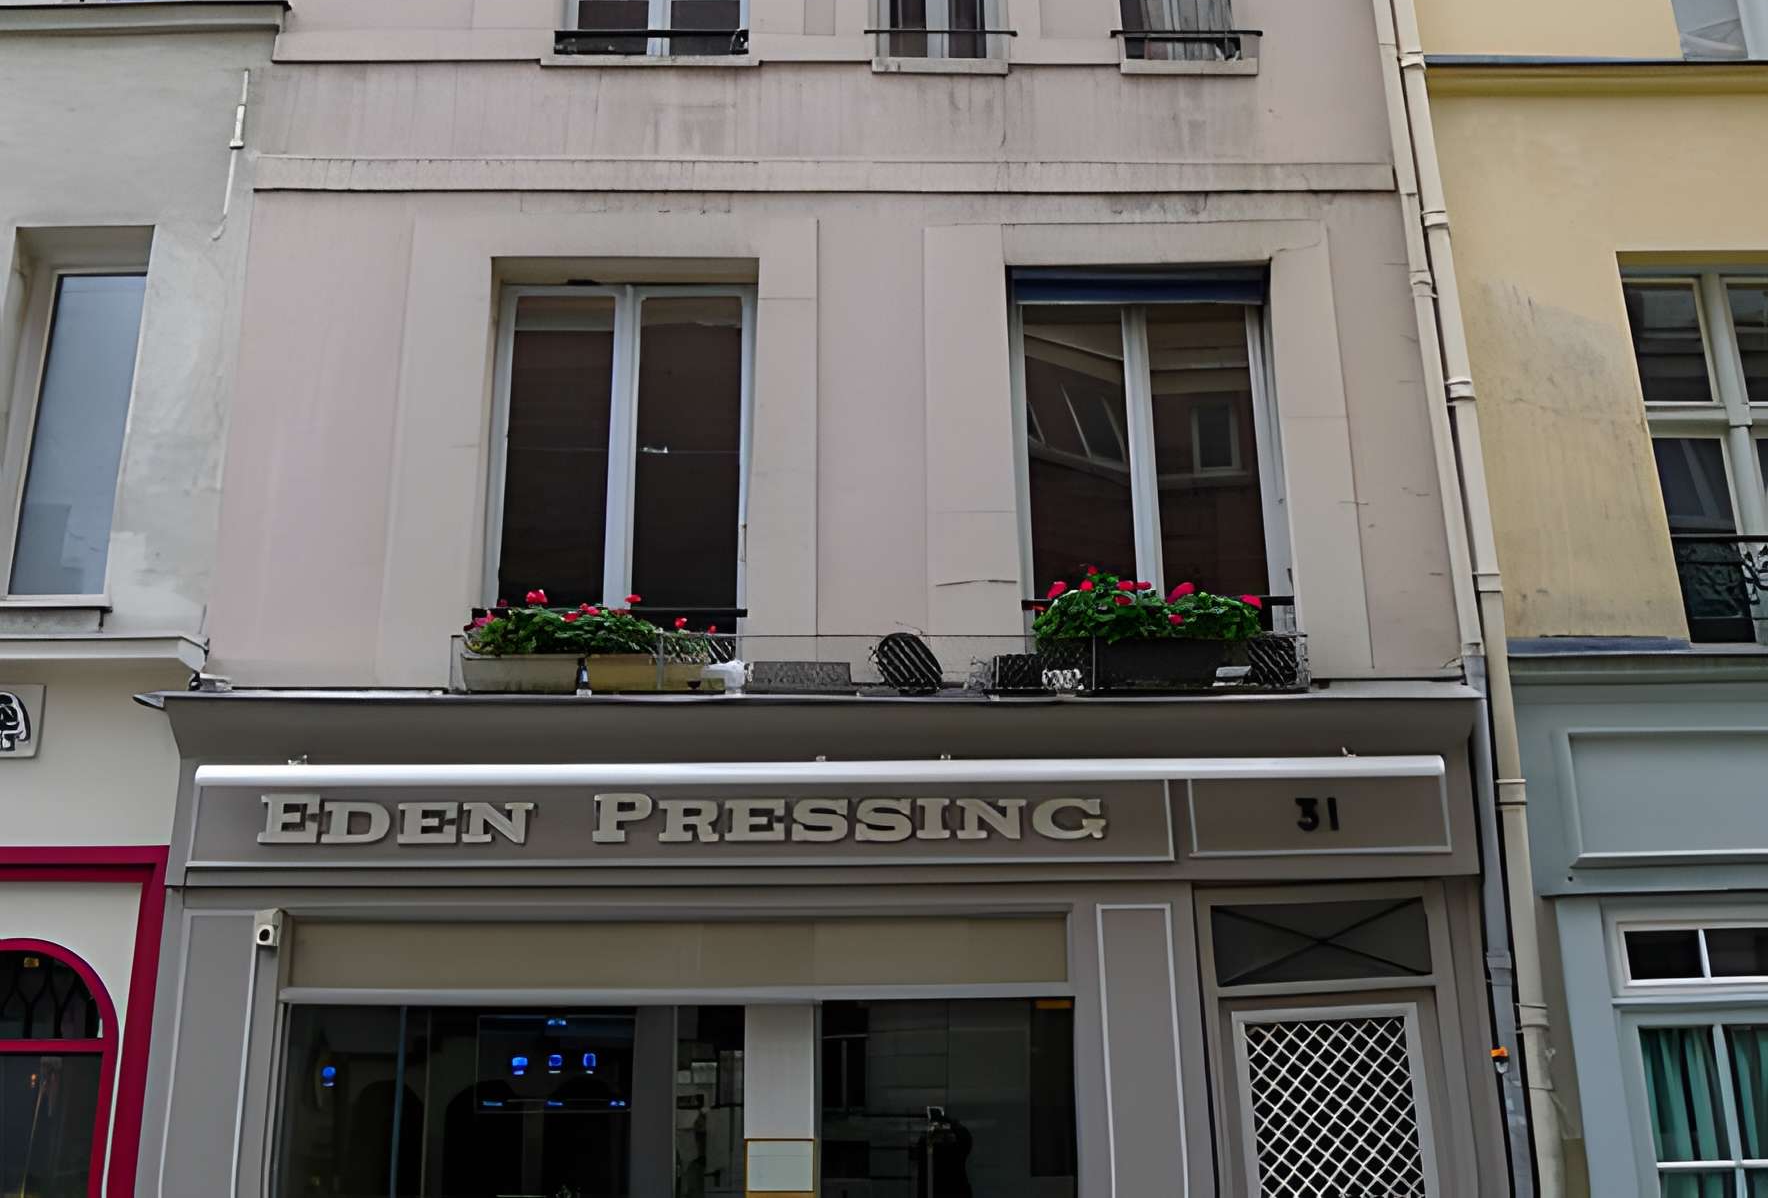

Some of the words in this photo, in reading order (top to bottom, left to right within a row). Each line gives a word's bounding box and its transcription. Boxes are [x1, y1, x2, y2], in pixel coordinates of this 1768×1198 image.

[256, 793, 535, 845] EDEN
[592, 792, 1107, 844] PRESSING
[1295, 796, 1340, 833] 31
